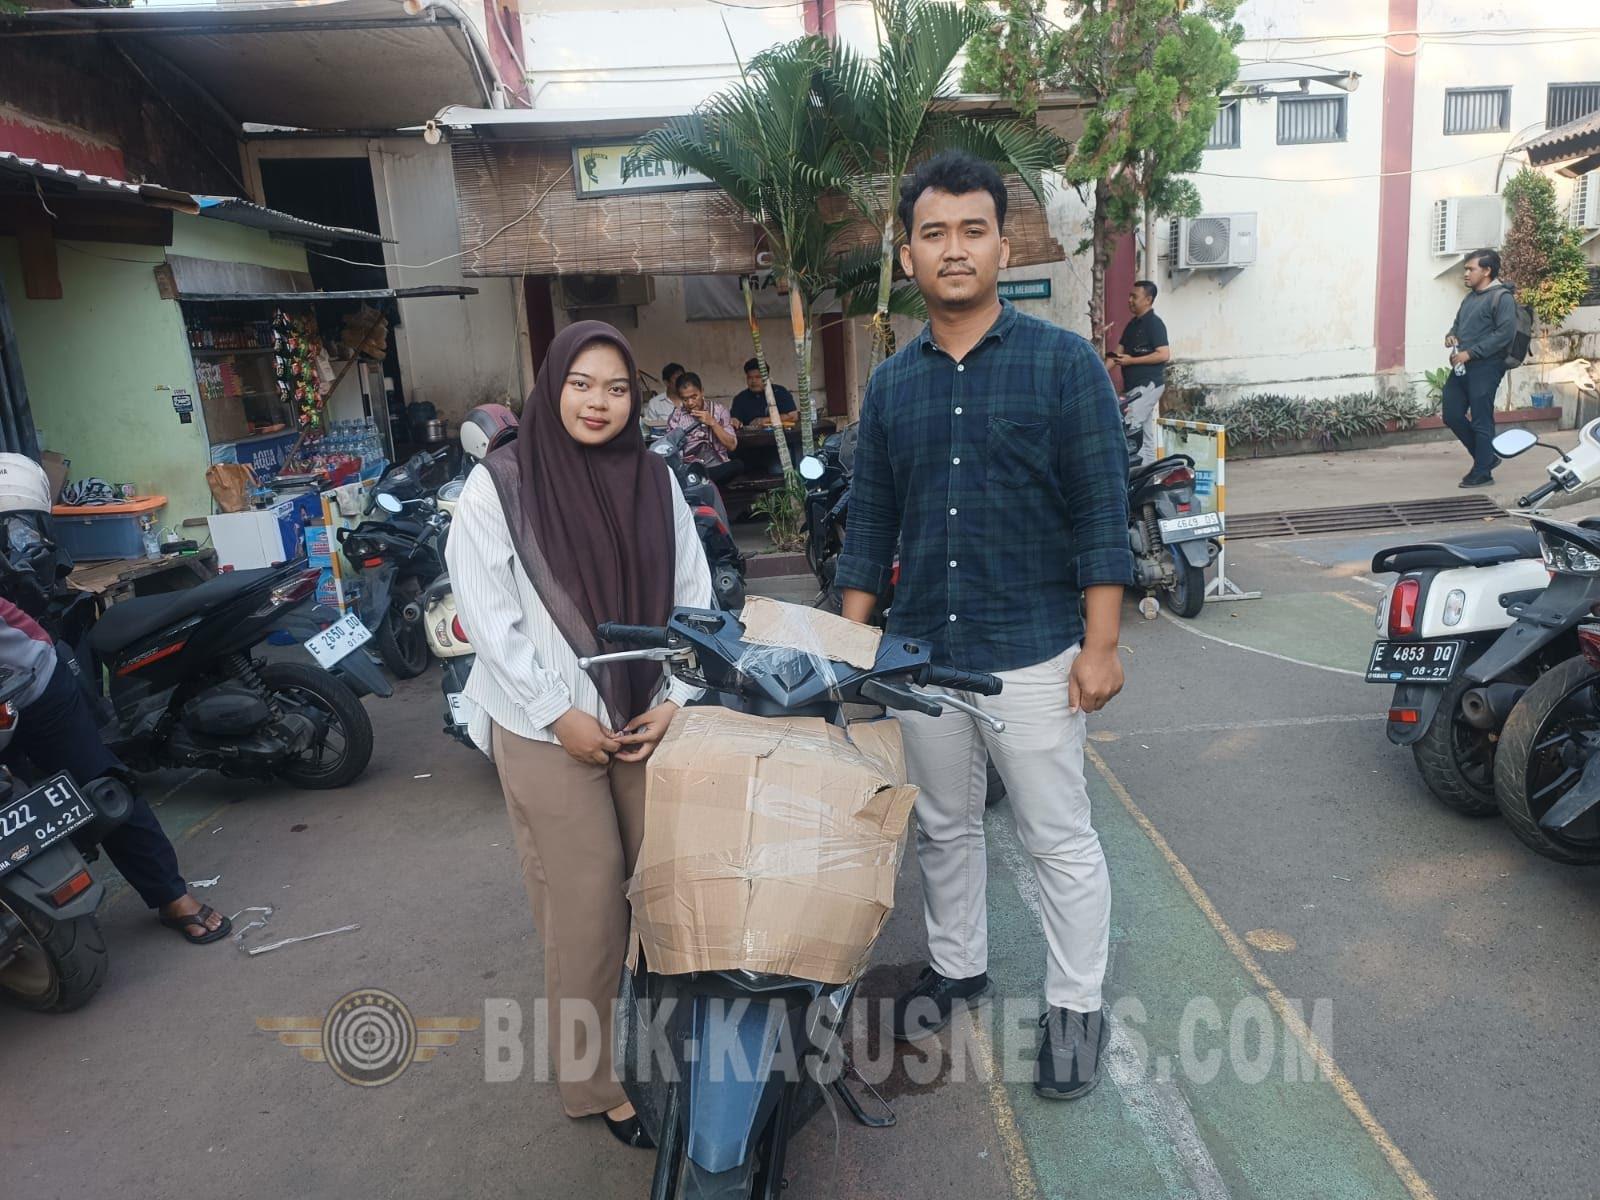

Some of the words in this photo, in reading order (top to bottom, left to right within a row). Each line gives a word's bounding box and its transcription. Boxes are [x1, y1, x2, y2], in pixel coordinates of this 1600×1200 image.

[252, 448, 277, 470] AQUA
[309, 643, 320, 654] E
[322, 626, 345, 647] 2650
[1375, 647, 1385, 661] E
[1393, 646, 1425, 661] 4853
[452, 696, 460, 709] E
[0, 804, 37, 840] 222
[44, 782, 71, 807] EI
